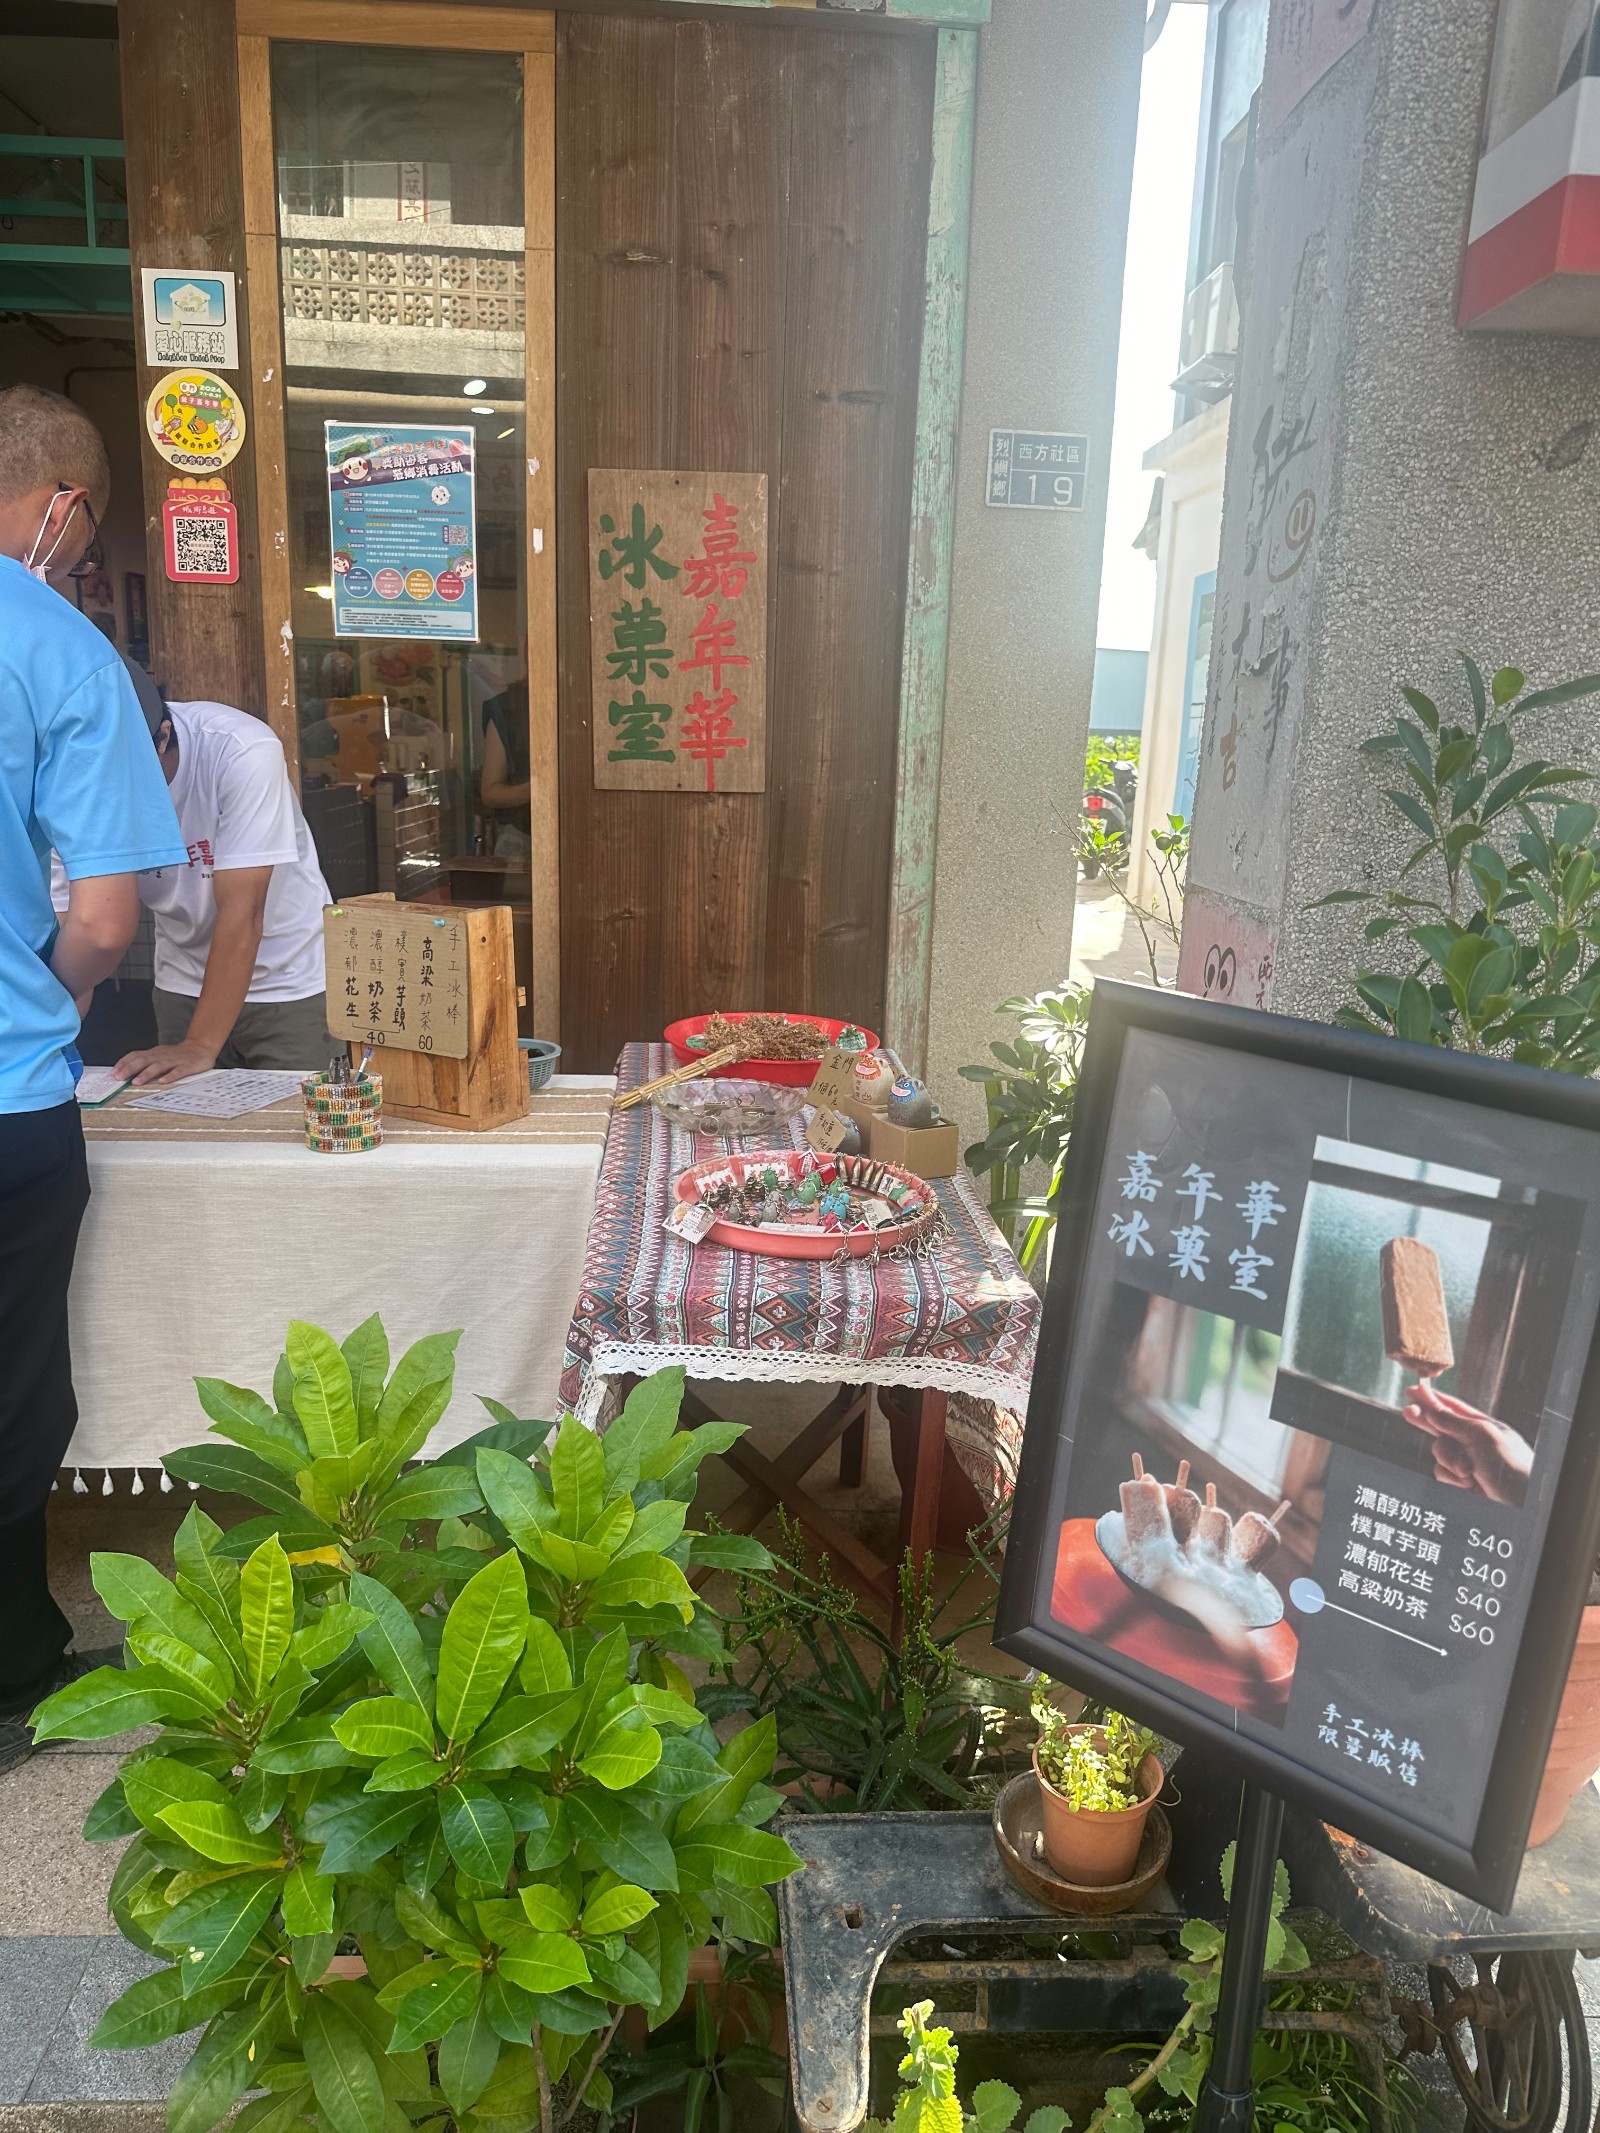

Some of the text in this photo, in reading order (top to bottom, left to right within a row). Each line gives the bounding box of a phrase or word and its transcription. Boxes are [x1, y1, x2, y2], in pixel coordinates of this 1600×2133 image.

[155, 330, 225, 354] 愛心服務站
[200, 385, 221, 393] 2024
[992, 438, 1009, 498] 烈嶼鄉
[1019, 443, 1080, 463] 西方社區
[1028, 474, 1073, 506] 19
[598, 502, 681, 763] 冰菓室
[679, 492, 757, 792] 嘉年華
[446, 924, 464, 1026] 手工冰棒
[367, 1031, 385, 1044] 40
[419, 1035, 433, 1050] 60
[829, 1054, 855, 1074] 金門
[1117, 1150, 1287, 1240] 嘉年華
[1107, 1210, 1274, 1300] 冰菓室
[1354, 1485, 1446, 1534] 濃醇奶茶
[1350, 1513, 1442, 1565] 樸實芋頭
[1344, 1540, 1434, 1593] 濃郁花生
[1318, 1724, 1418, 1786] 限量販售
[1322, 1703, 1424, 1761] 手工冰棒
